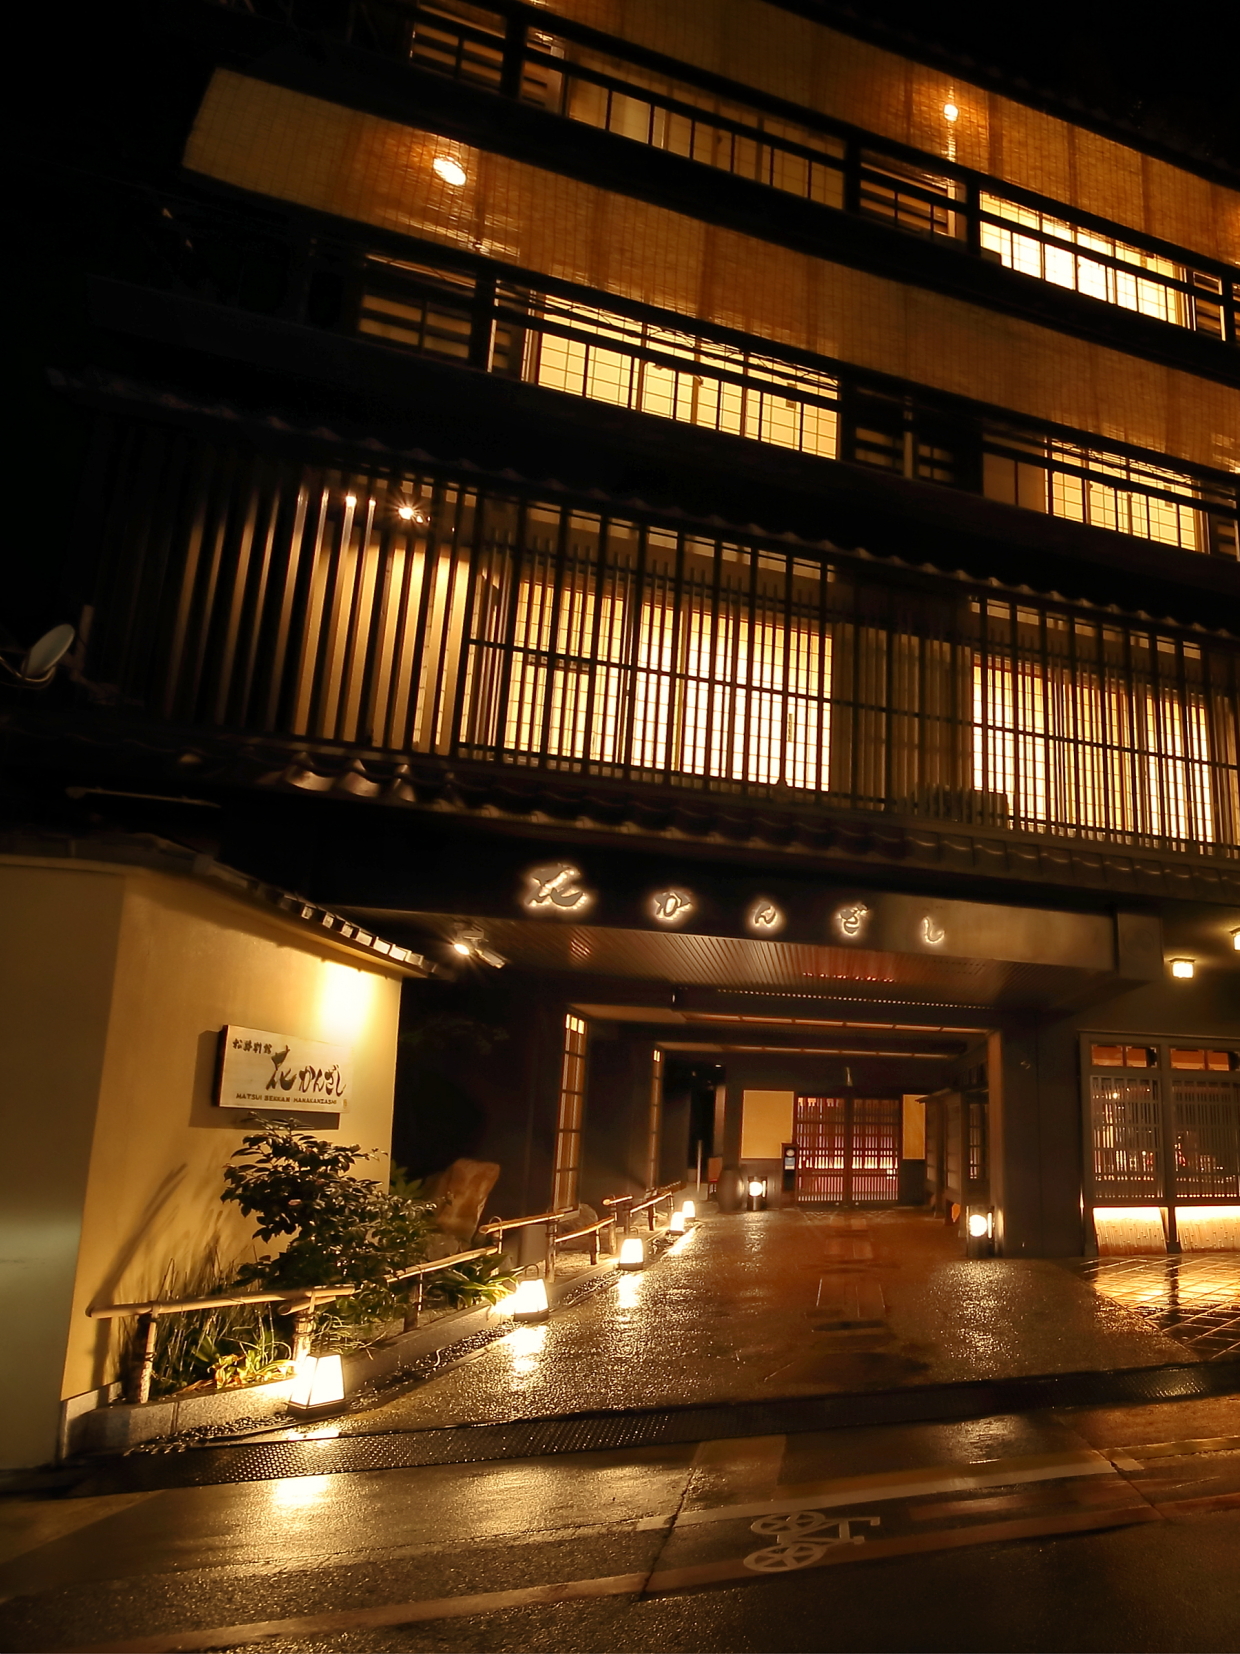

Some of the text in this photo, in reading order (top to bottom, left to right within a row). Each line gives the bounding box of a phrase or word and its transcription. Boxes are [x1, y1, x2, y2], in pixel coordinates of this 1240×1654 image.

[526, 864, 945, 944] 花かんざし
[266, 1045, 346, 1097] 花かんざし
